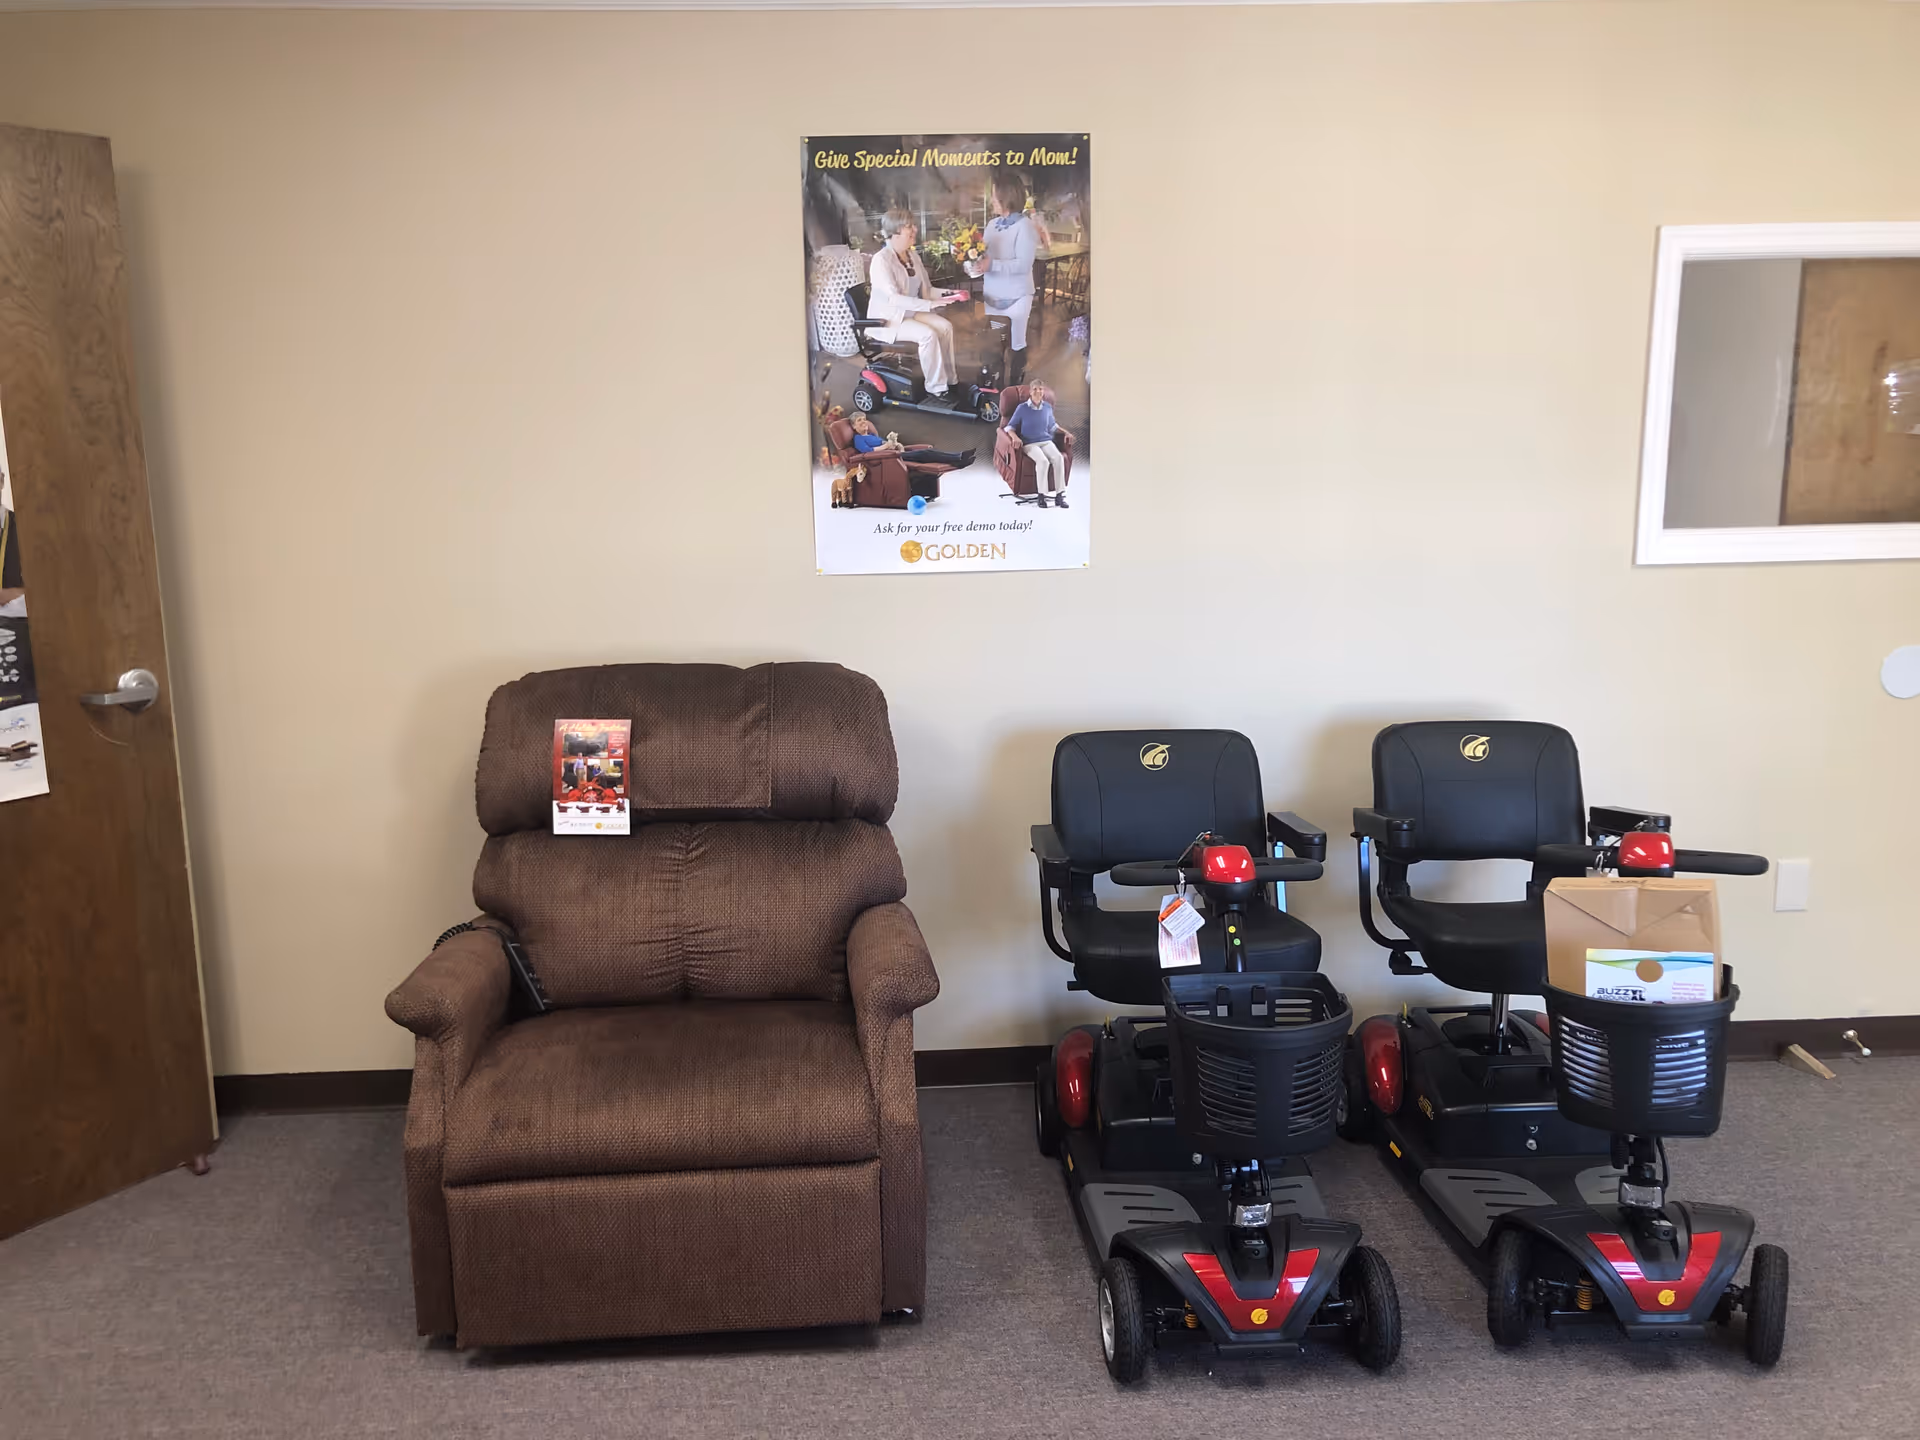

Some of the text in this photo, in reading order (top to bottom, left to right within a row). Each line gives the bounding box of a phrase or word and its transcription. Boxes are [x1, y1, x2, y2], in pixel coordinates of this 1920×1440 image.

[814, 146, 1078, 172] Give Special Moments to Mom!
[873, 519, 1033, 536] Ask for your free demo today!
[924, 542, 1007, 561] GOLDEN
[1596, 987, 1631, 996] BUZZ
